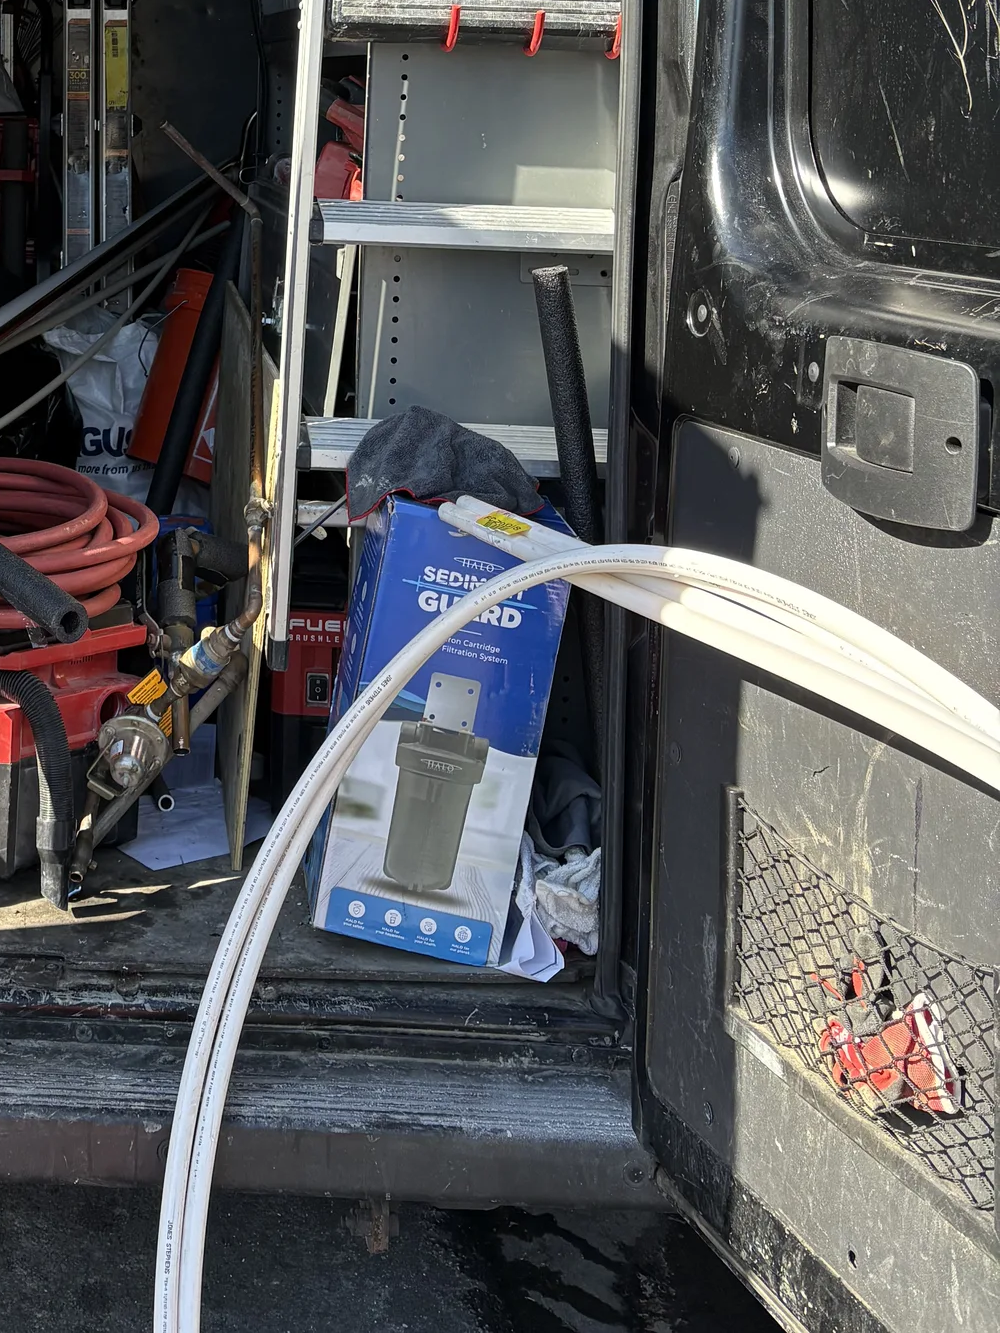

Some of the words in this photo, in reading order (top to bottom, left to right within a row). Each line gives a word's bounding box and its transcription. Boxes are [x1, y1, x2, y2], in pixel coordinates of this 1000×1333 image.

[69, 71, 87, 79] 300
[80, 427, 132, 458] GU
[78, 465, 100, 474] more
[102, 464, 128, 475] from
[461, 557, 495, 573] HALO
[417, 590, 522, 629] GURD
[287, 633, 340, 644] BRUSHLE
[463, 639, 501, 654] Cartridge
[441, 644, 478, 659] Filtration
[479, 652, 508, 665] System
[164, 1243, 172, 1274] STEPHENS
